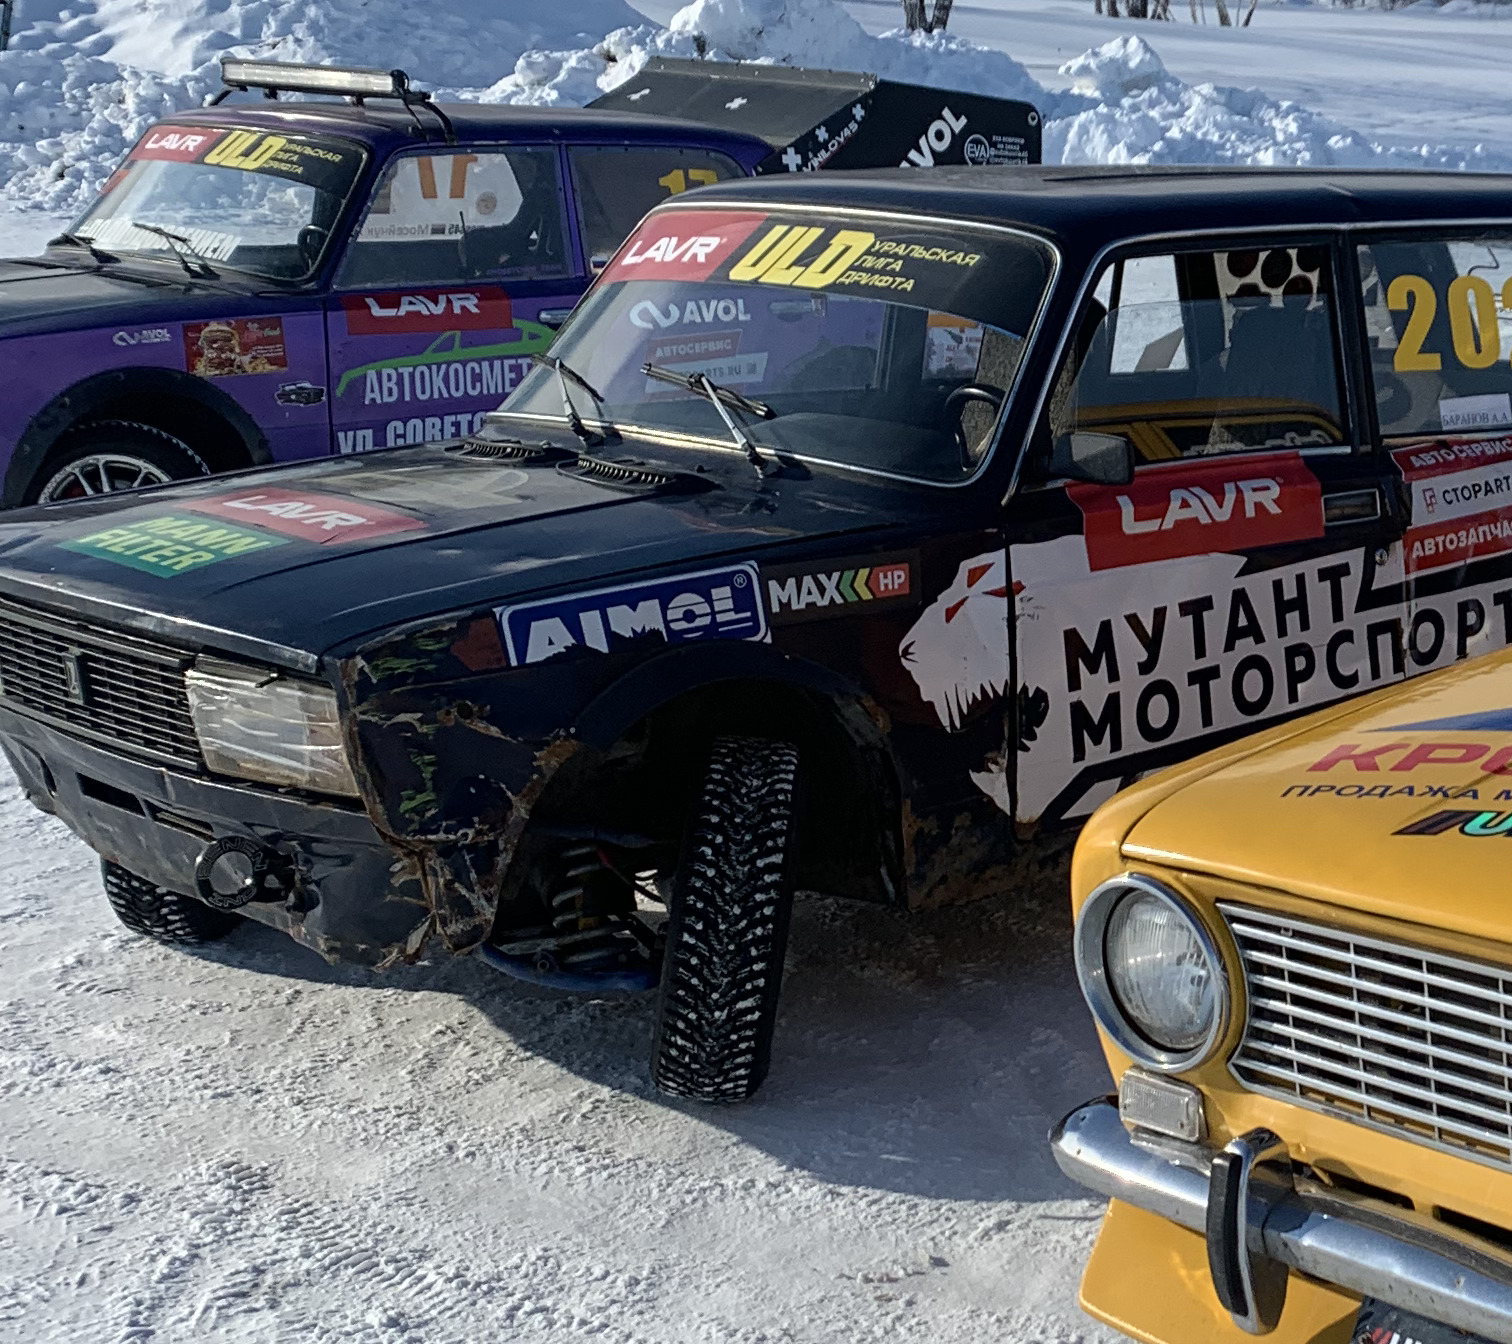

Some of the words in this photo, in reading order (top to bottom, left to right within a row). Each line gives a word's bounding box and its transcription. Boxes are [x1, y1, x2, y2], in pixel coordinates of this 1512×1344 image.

[144, 132, 204, 152] LAVR
[203, 130, 287, 171] ULD
[899, 106, 968, 168] VOL
[621, 236, 720, 266] LAVR
[729, 224, 876, 289] ULD
[854, 253, 903, 273] ЛИГА
[869, 239, 981, 267] УРАЛЬСКАЯ
[836, 269, 916, 292] ДРИФТА
[365, 292, 481, 317] LAVR
[683, 297, 752, 324] AVOL
[655, 338, 733, 358] АВТОСЕРВИС
[1442, 411, 1490, 426] БАРАНОВ
[222, 495, 368, 531] LAVR
[1120, 478, 1282, 534] LAVR
[79, 528, 216, 570] FILTER
[128, 516, 272, 556] MANN
[767, 570, 845, 614] MAX
[878, 568, 907, 592] HP
[525, 585, 754, 664] AIMOL
[1063, 562, 1352, 694] МУТАНТ
[1281, 784, 1480, 801] ПРОДАЖА
